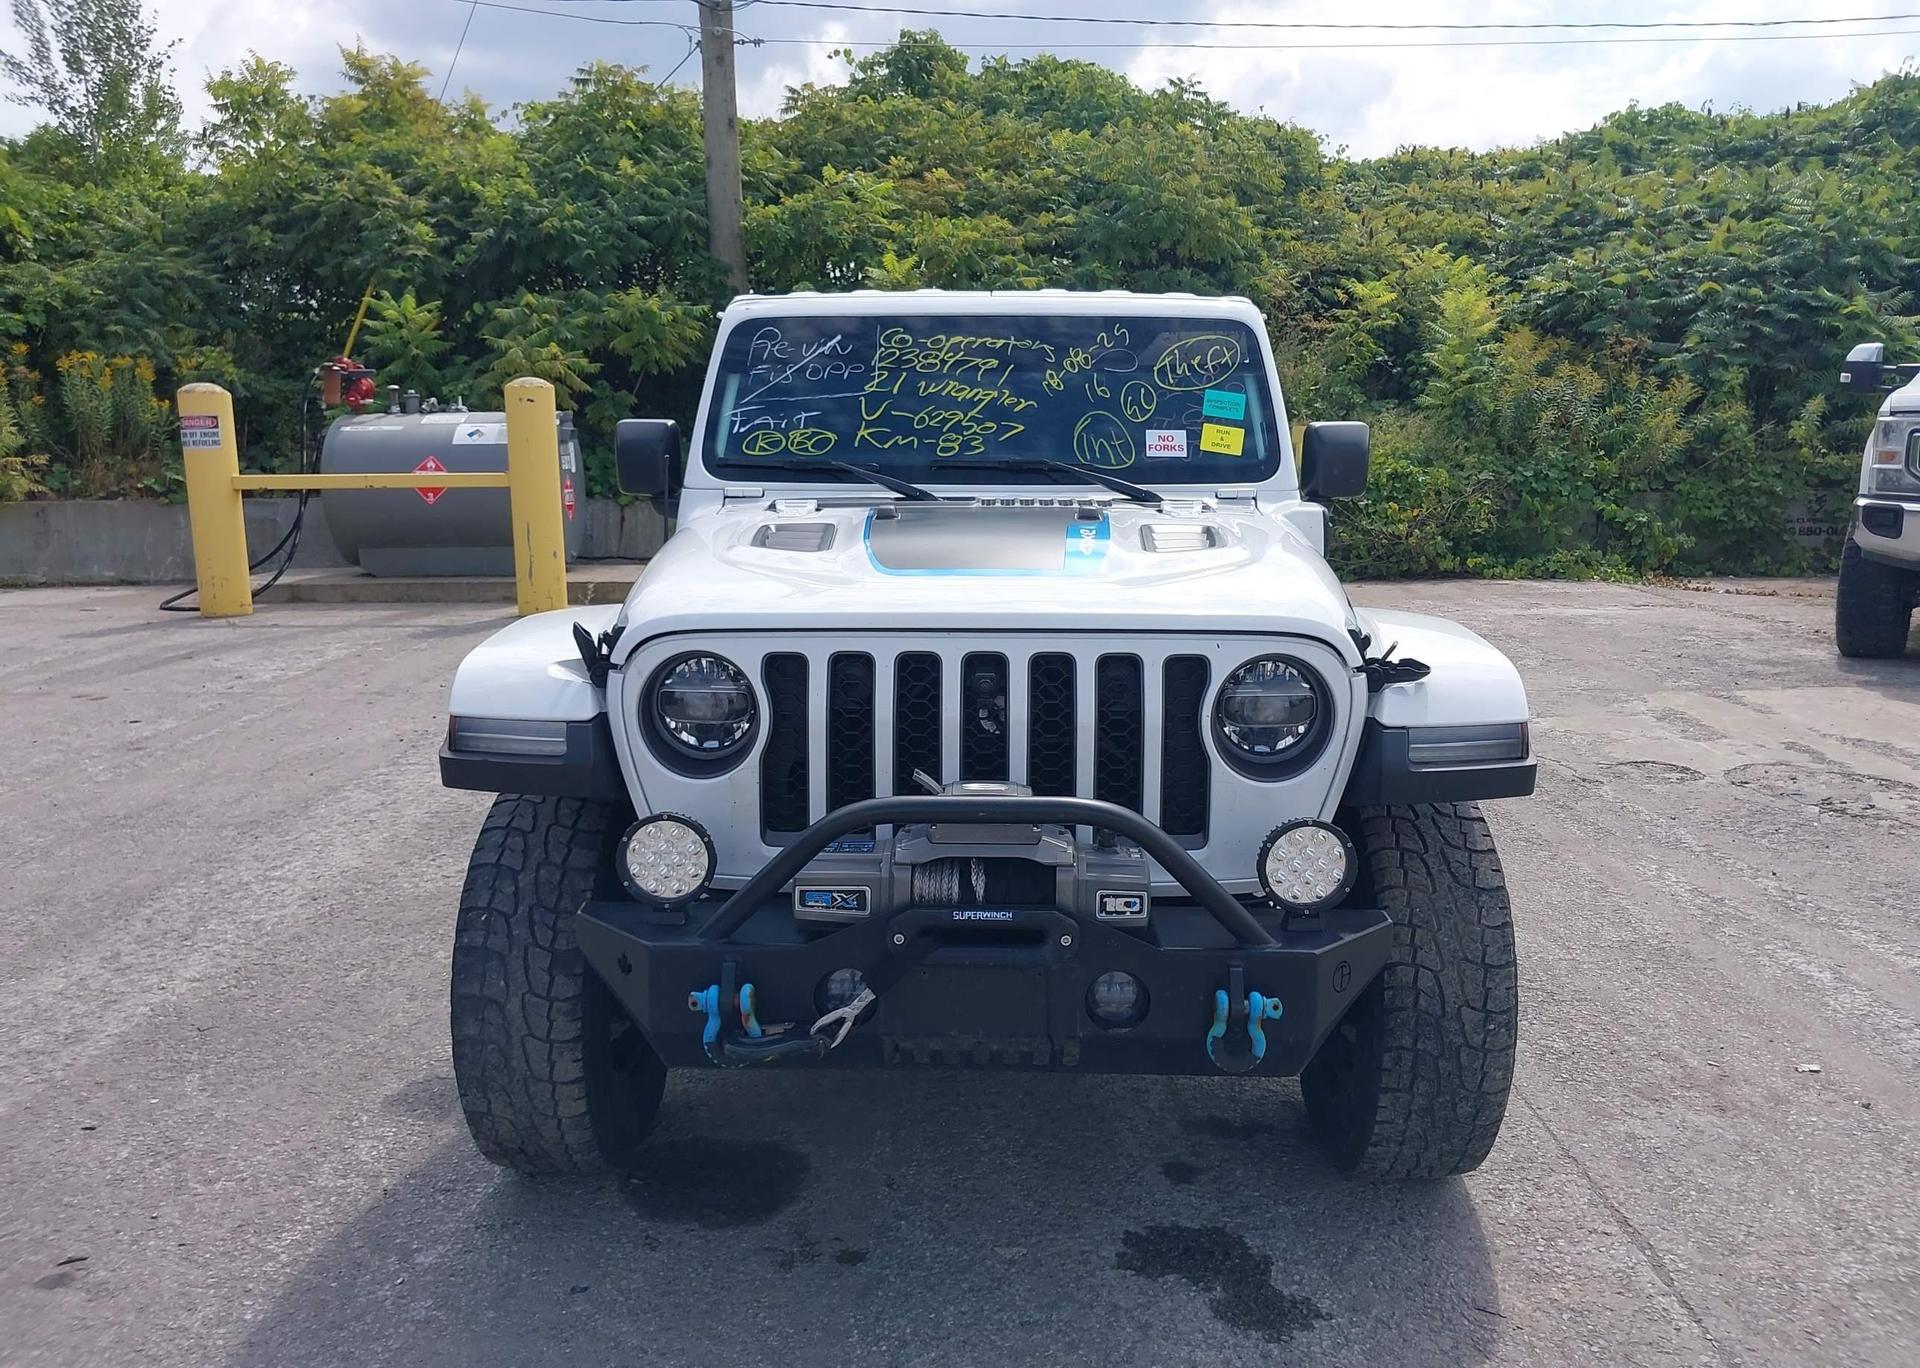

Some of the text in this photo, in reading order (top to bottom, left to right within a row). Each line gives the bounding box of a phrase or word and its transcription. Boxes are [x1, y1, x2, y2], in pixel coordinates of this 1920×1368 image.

[863, 369, 908, 395] 21
[1084, 371, 1111, 403] 16
[1157, 434, 1175, 443] NO
[1148, 443, 1185, 453] FORKS
[1211, 441, 1231, 450] DRIVE
[952, 911, 1012, 921] SUPERWINCH
